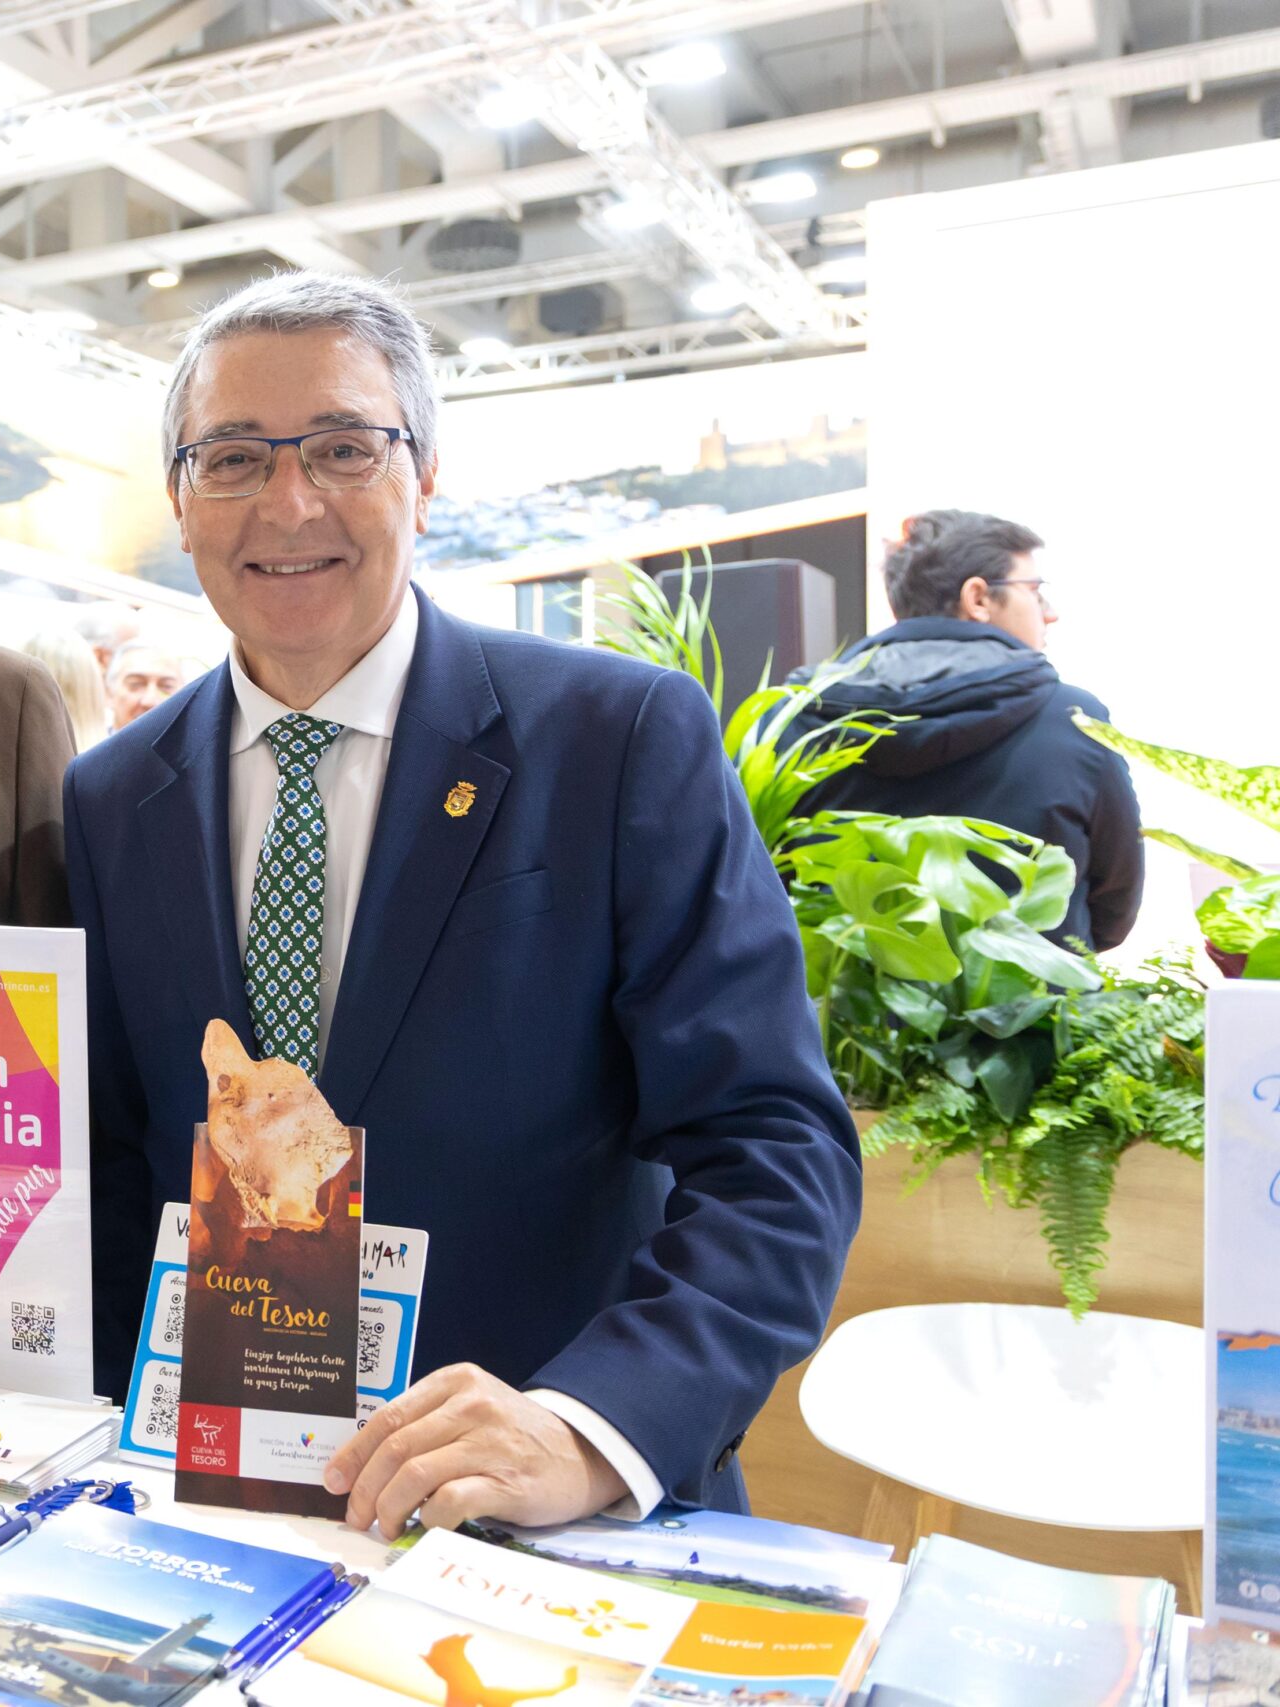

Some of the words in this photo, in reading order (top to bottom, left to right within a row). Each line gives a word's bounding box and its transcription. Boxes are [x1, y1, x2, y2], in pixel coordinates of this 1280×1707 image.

[13, 1164, 55, 1217] pur
[205, 1264, 273, 1294] Cueva
[230, 1299, 256, 1318] del
[257, 1296, 331, 1329] Tesoro
[244, 1347, 274, 1363] Einzige
[243, 1376, 253, 1387] in
[255, 1379, 278, 1391] ganz
[190, 1445, 213, 1455] CUEVA
[213, 1448, 226, 1457] DEL
[191, 1455, 227, 1468] TESORO
[109, 1541, 232, 1579] TORROX
